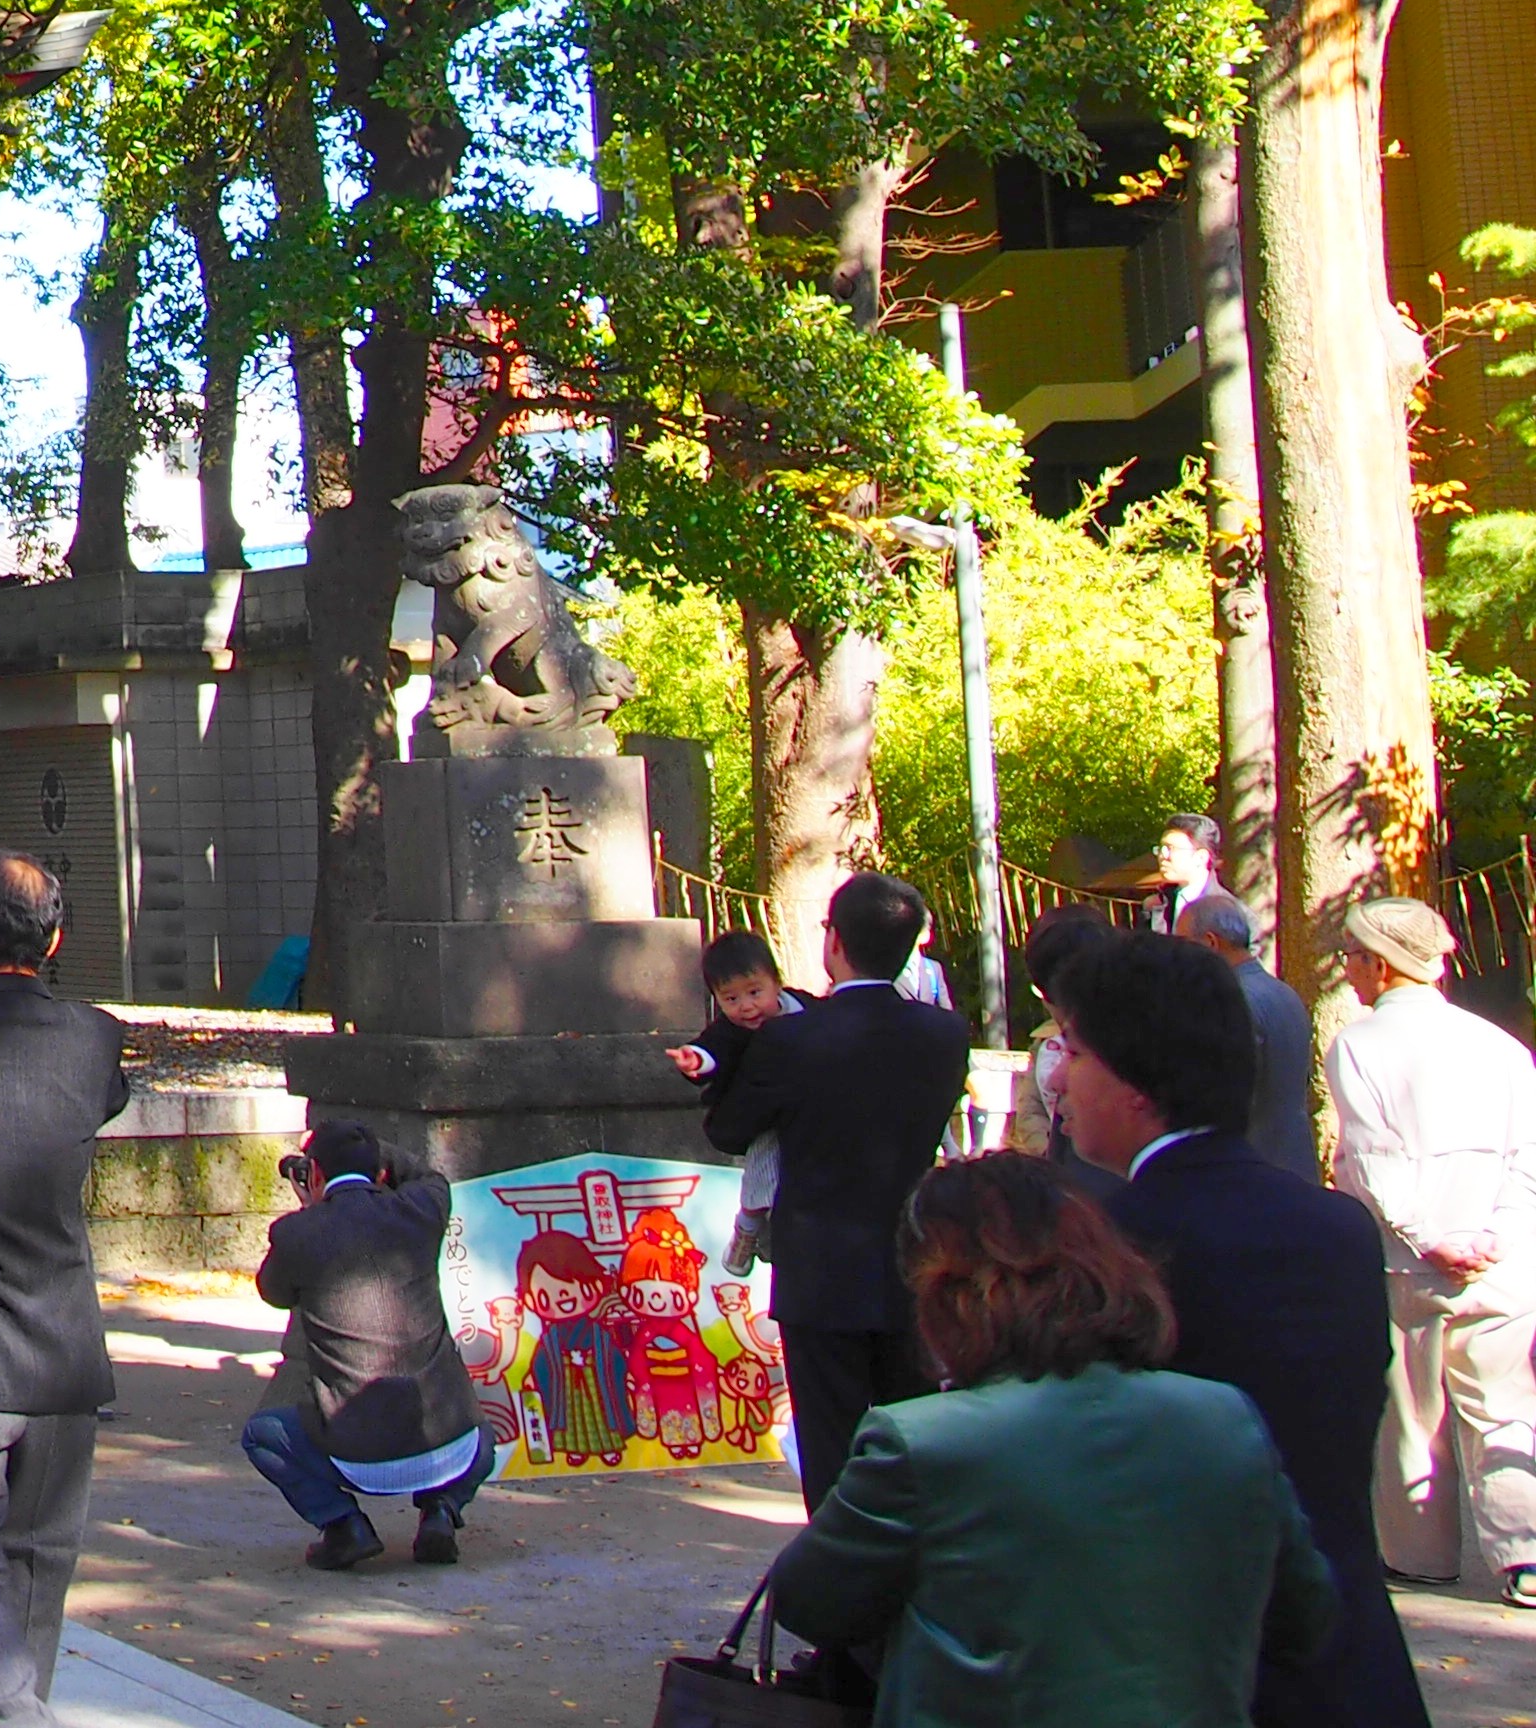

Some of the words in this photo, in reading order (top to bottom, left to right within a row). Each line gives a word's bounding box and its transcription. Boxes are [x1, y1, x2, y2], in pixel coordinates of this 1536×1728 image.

[514, 786, 590, 879] 奉
[445, 1216, 476, 1342] おめでとう
